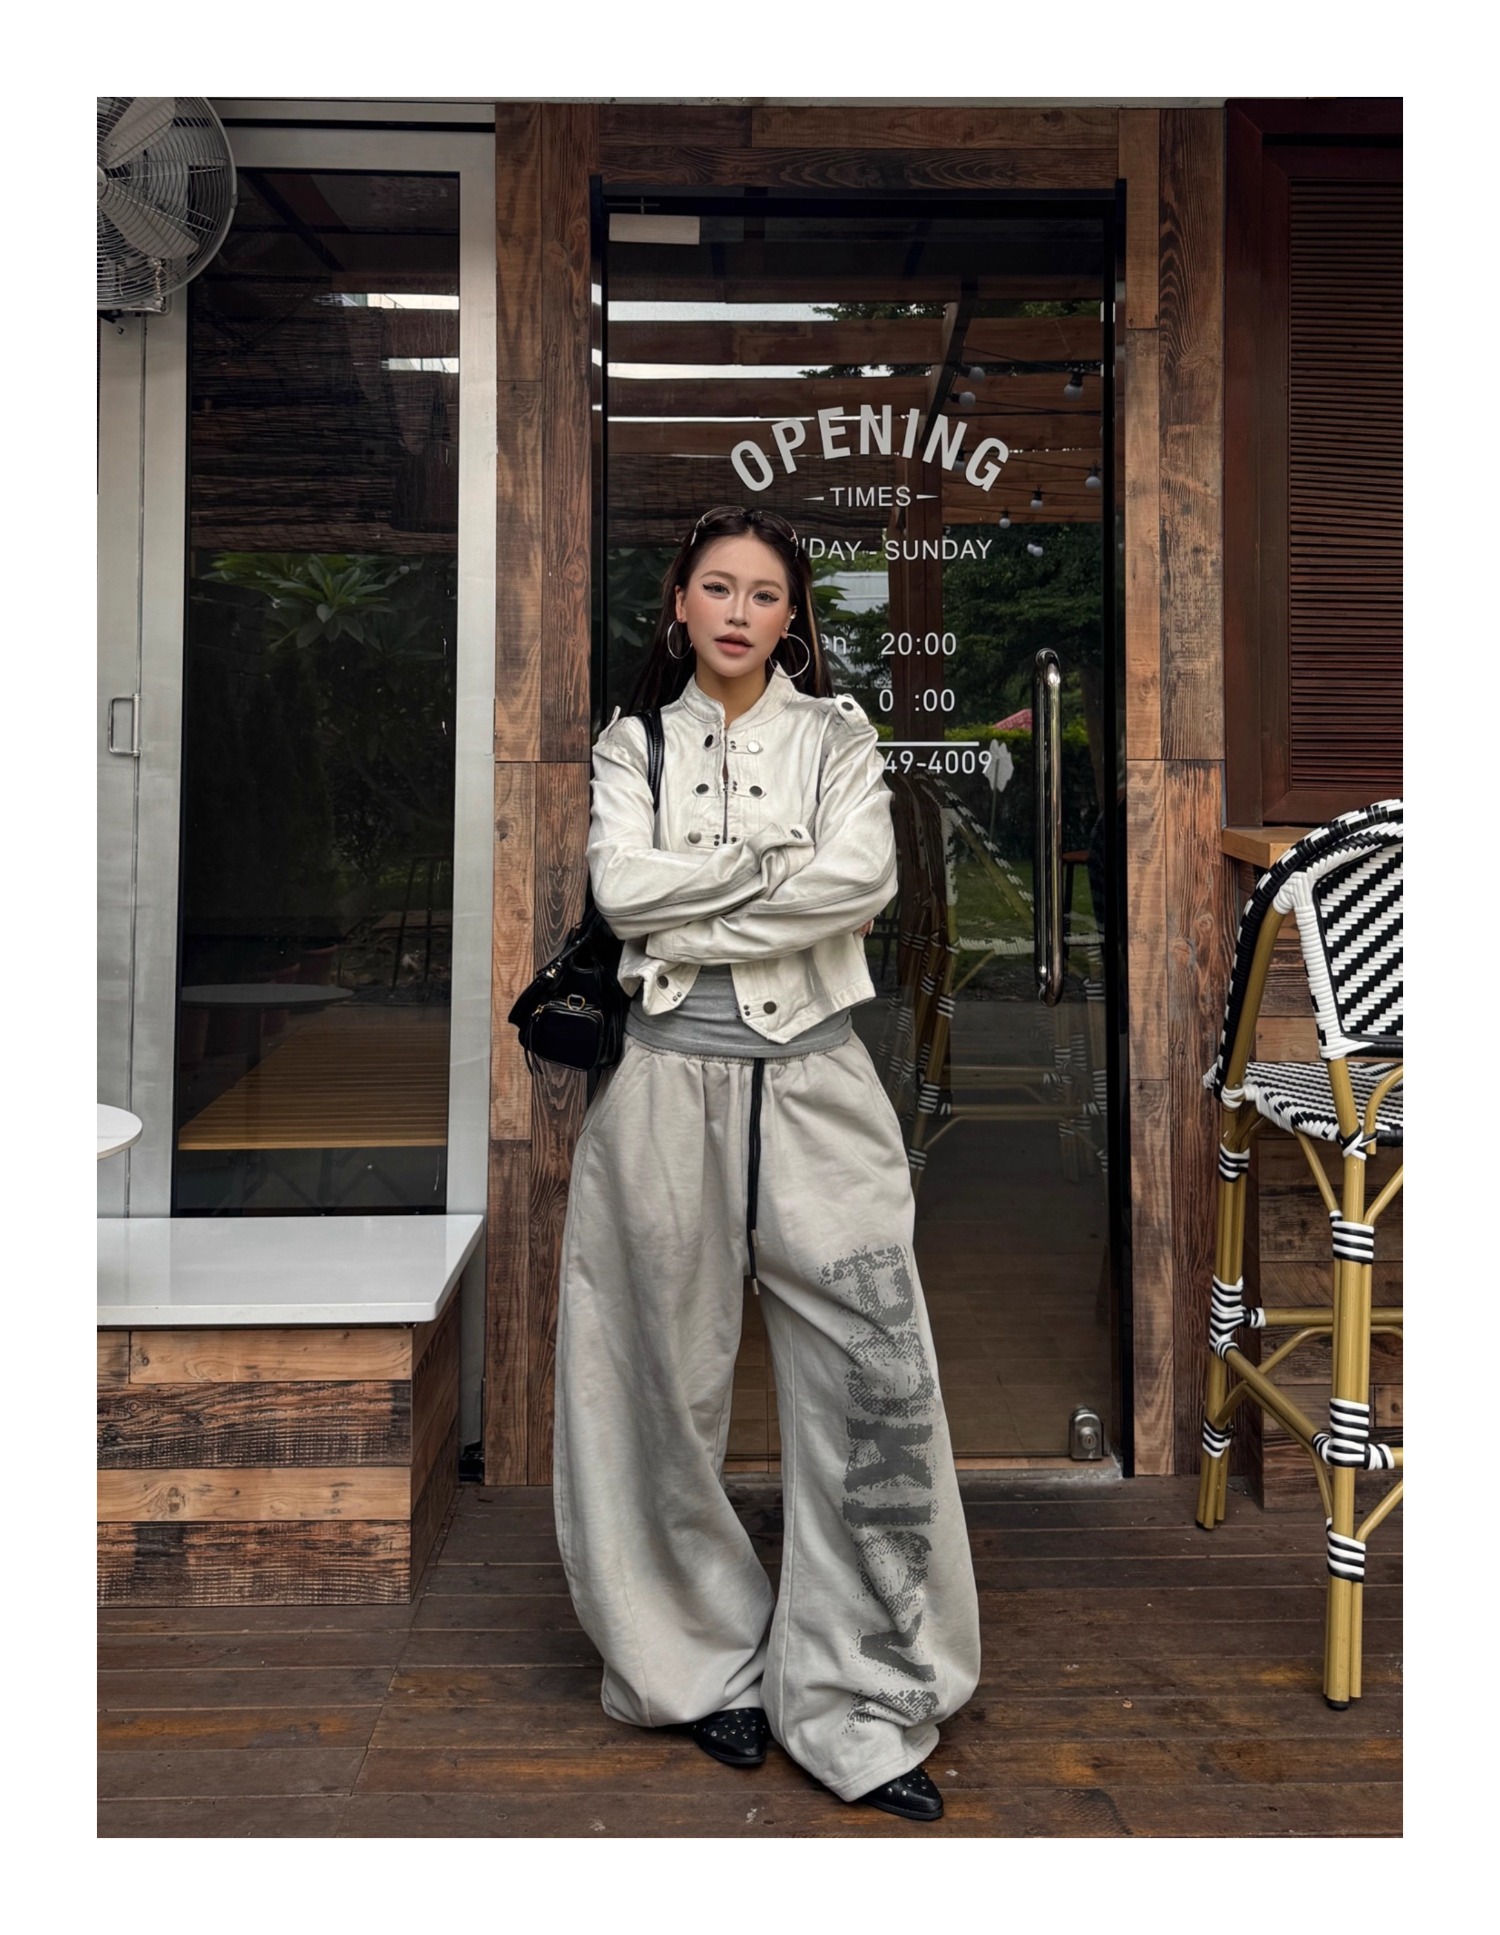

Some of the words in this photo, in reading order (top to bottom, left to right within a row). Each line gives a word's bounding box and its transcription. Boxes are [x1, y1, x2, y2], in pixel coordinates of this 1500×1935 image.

[730, 404, 1009, 492] OPENING
[829, 485, 912, 507] TIMES
[884, 539, 992, 560] SUNDAY
[880, 632, 957, 655] 20:00
